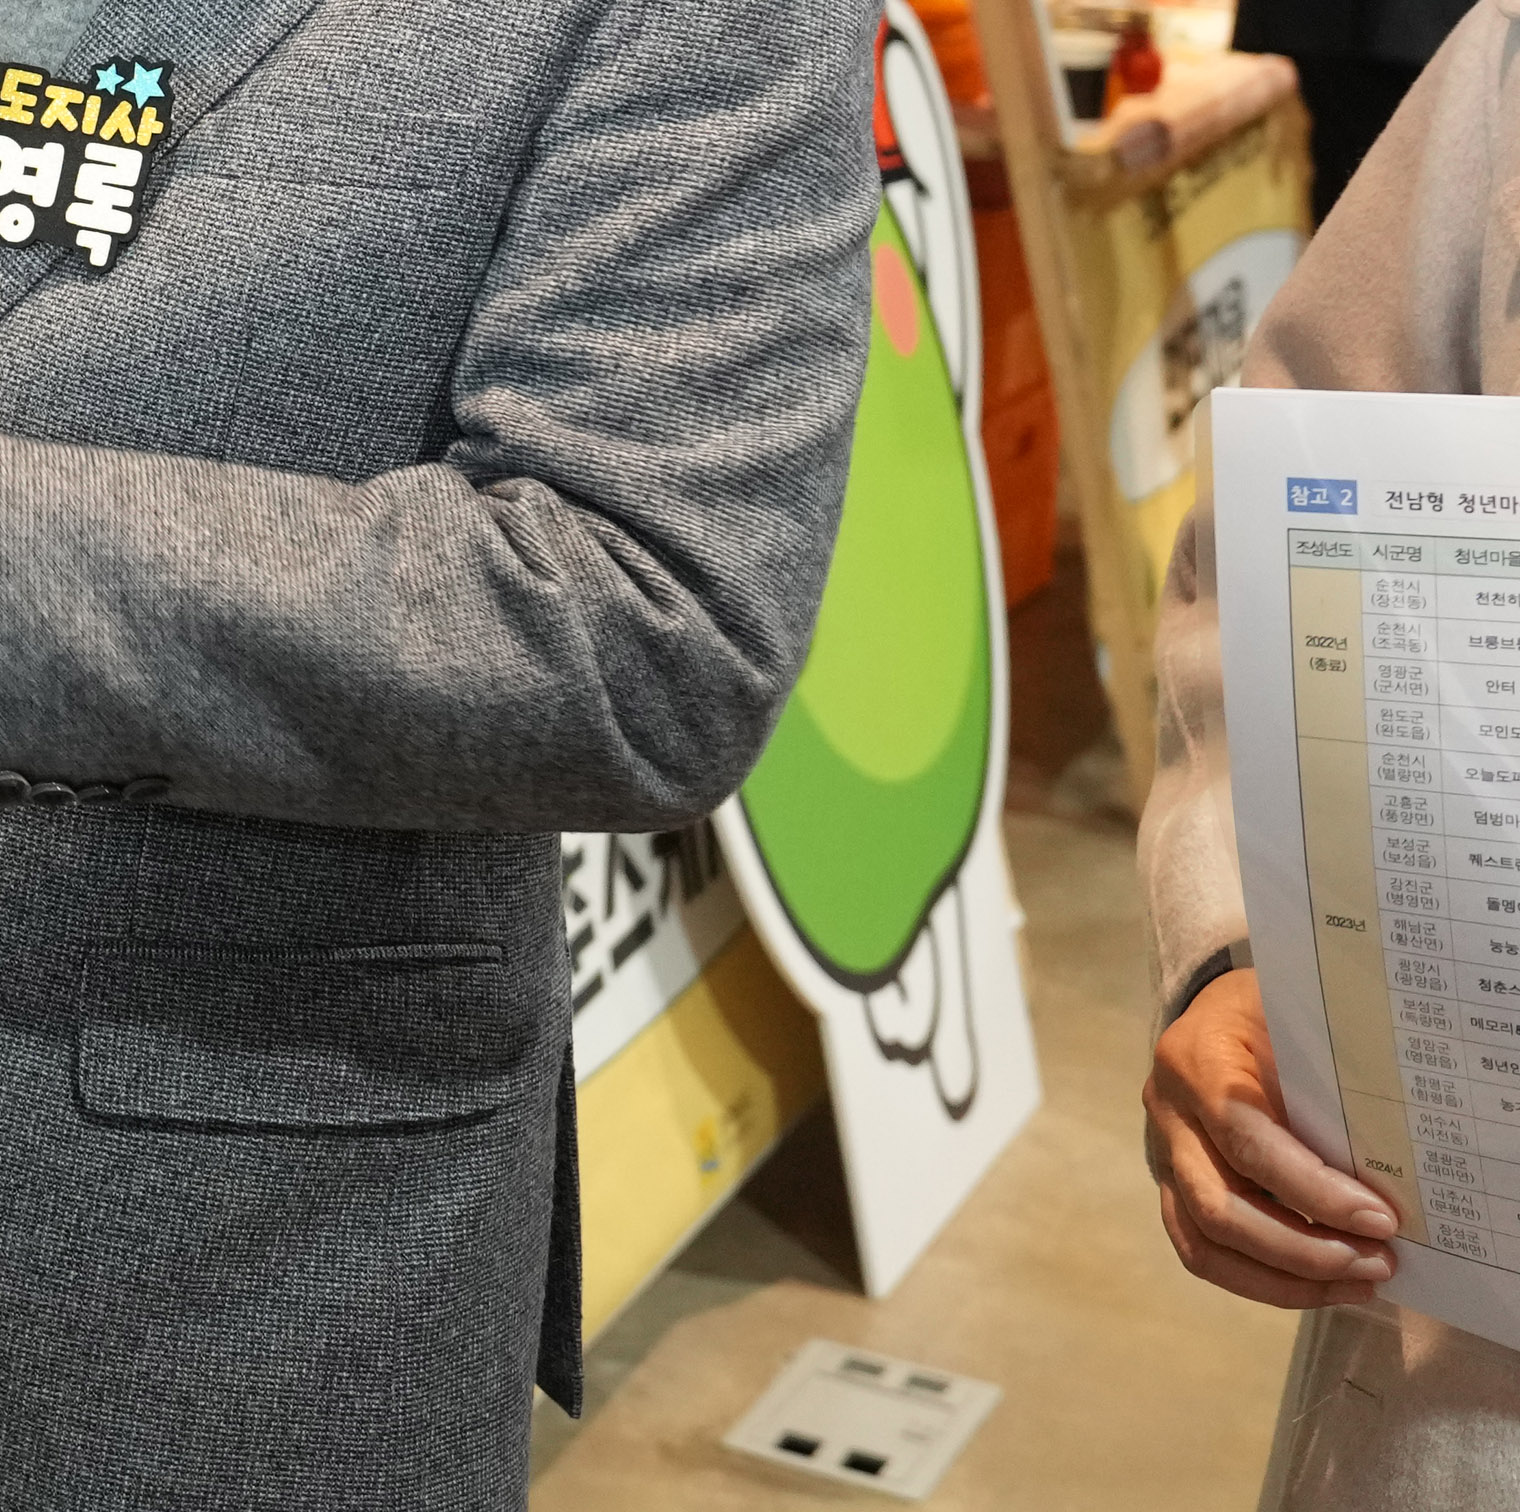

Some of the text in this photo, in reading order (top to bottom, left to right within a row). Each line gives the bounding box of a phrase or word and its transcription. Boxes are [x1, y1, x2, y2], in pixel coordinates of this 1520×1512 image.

[1291, 486, 1352, 506] 참고 2
[1385, 491, 1443, 512] 전남형
[1296, 541, 1354, 557] 조성년도
[1373, 544, 1422, 562] 시군명
[1375, 579, 1421, 594] 순천시
[1371, 594, 1427, 610] (장천동)
[1377, 622, 1421, 636] 순천시
[1305, 635, 1349, 651] 2022년
[1372, 638, 1427, 653] (조곡동)
[1309, 657, 1347, 673] (종료)
[1378, 664, 1423, 679] 영광군
[1374, 680, 1429, 696] (군서면)
[1485, 680, 1516, 696] 안터
[1380, 709, 1424, 724] 완도군
[1375, 723, 1431, 740] (완도읍)
[1382, 752, 1426, 768] 순천시
[1377, 766, 1432, 784] (별량면)
[1384, 795, 1428, 811] 고흥군
[1387, 837, 1431, 853] 보성군
[1383, 850, 1437, 869] (보성읍)
[1390, 877, 1433, 894] 강진군
[1486, 897, 1520, 914] 돌멩
[1325, 915, 1367, 932] 2023년
[1394, 919, 1436, 935] 해남군
[1398, 959, 1440, 977] 광양시
[1395, 972, 1448, 991] (광양읍)
[1403, 999, 1445, 1016] 보성군
[1408, 1037, 1450, 1054] 영암군
[1414, 1074, 1456, 1092] 함평군
[1420, 1113, 1462, 1131] 여수시
[1417, 1126, 1469, 1147] (시전동)
[1365, 1158, 1404, 1178] 2024년
[1426, 1150, 1467, 1170] 영광군
[1424, 1163, 1476, 1184] (대마면)
[1432, 1187, 1473, 1205] 나주시
[1439, 1223, 1480, 1242] 장성군
